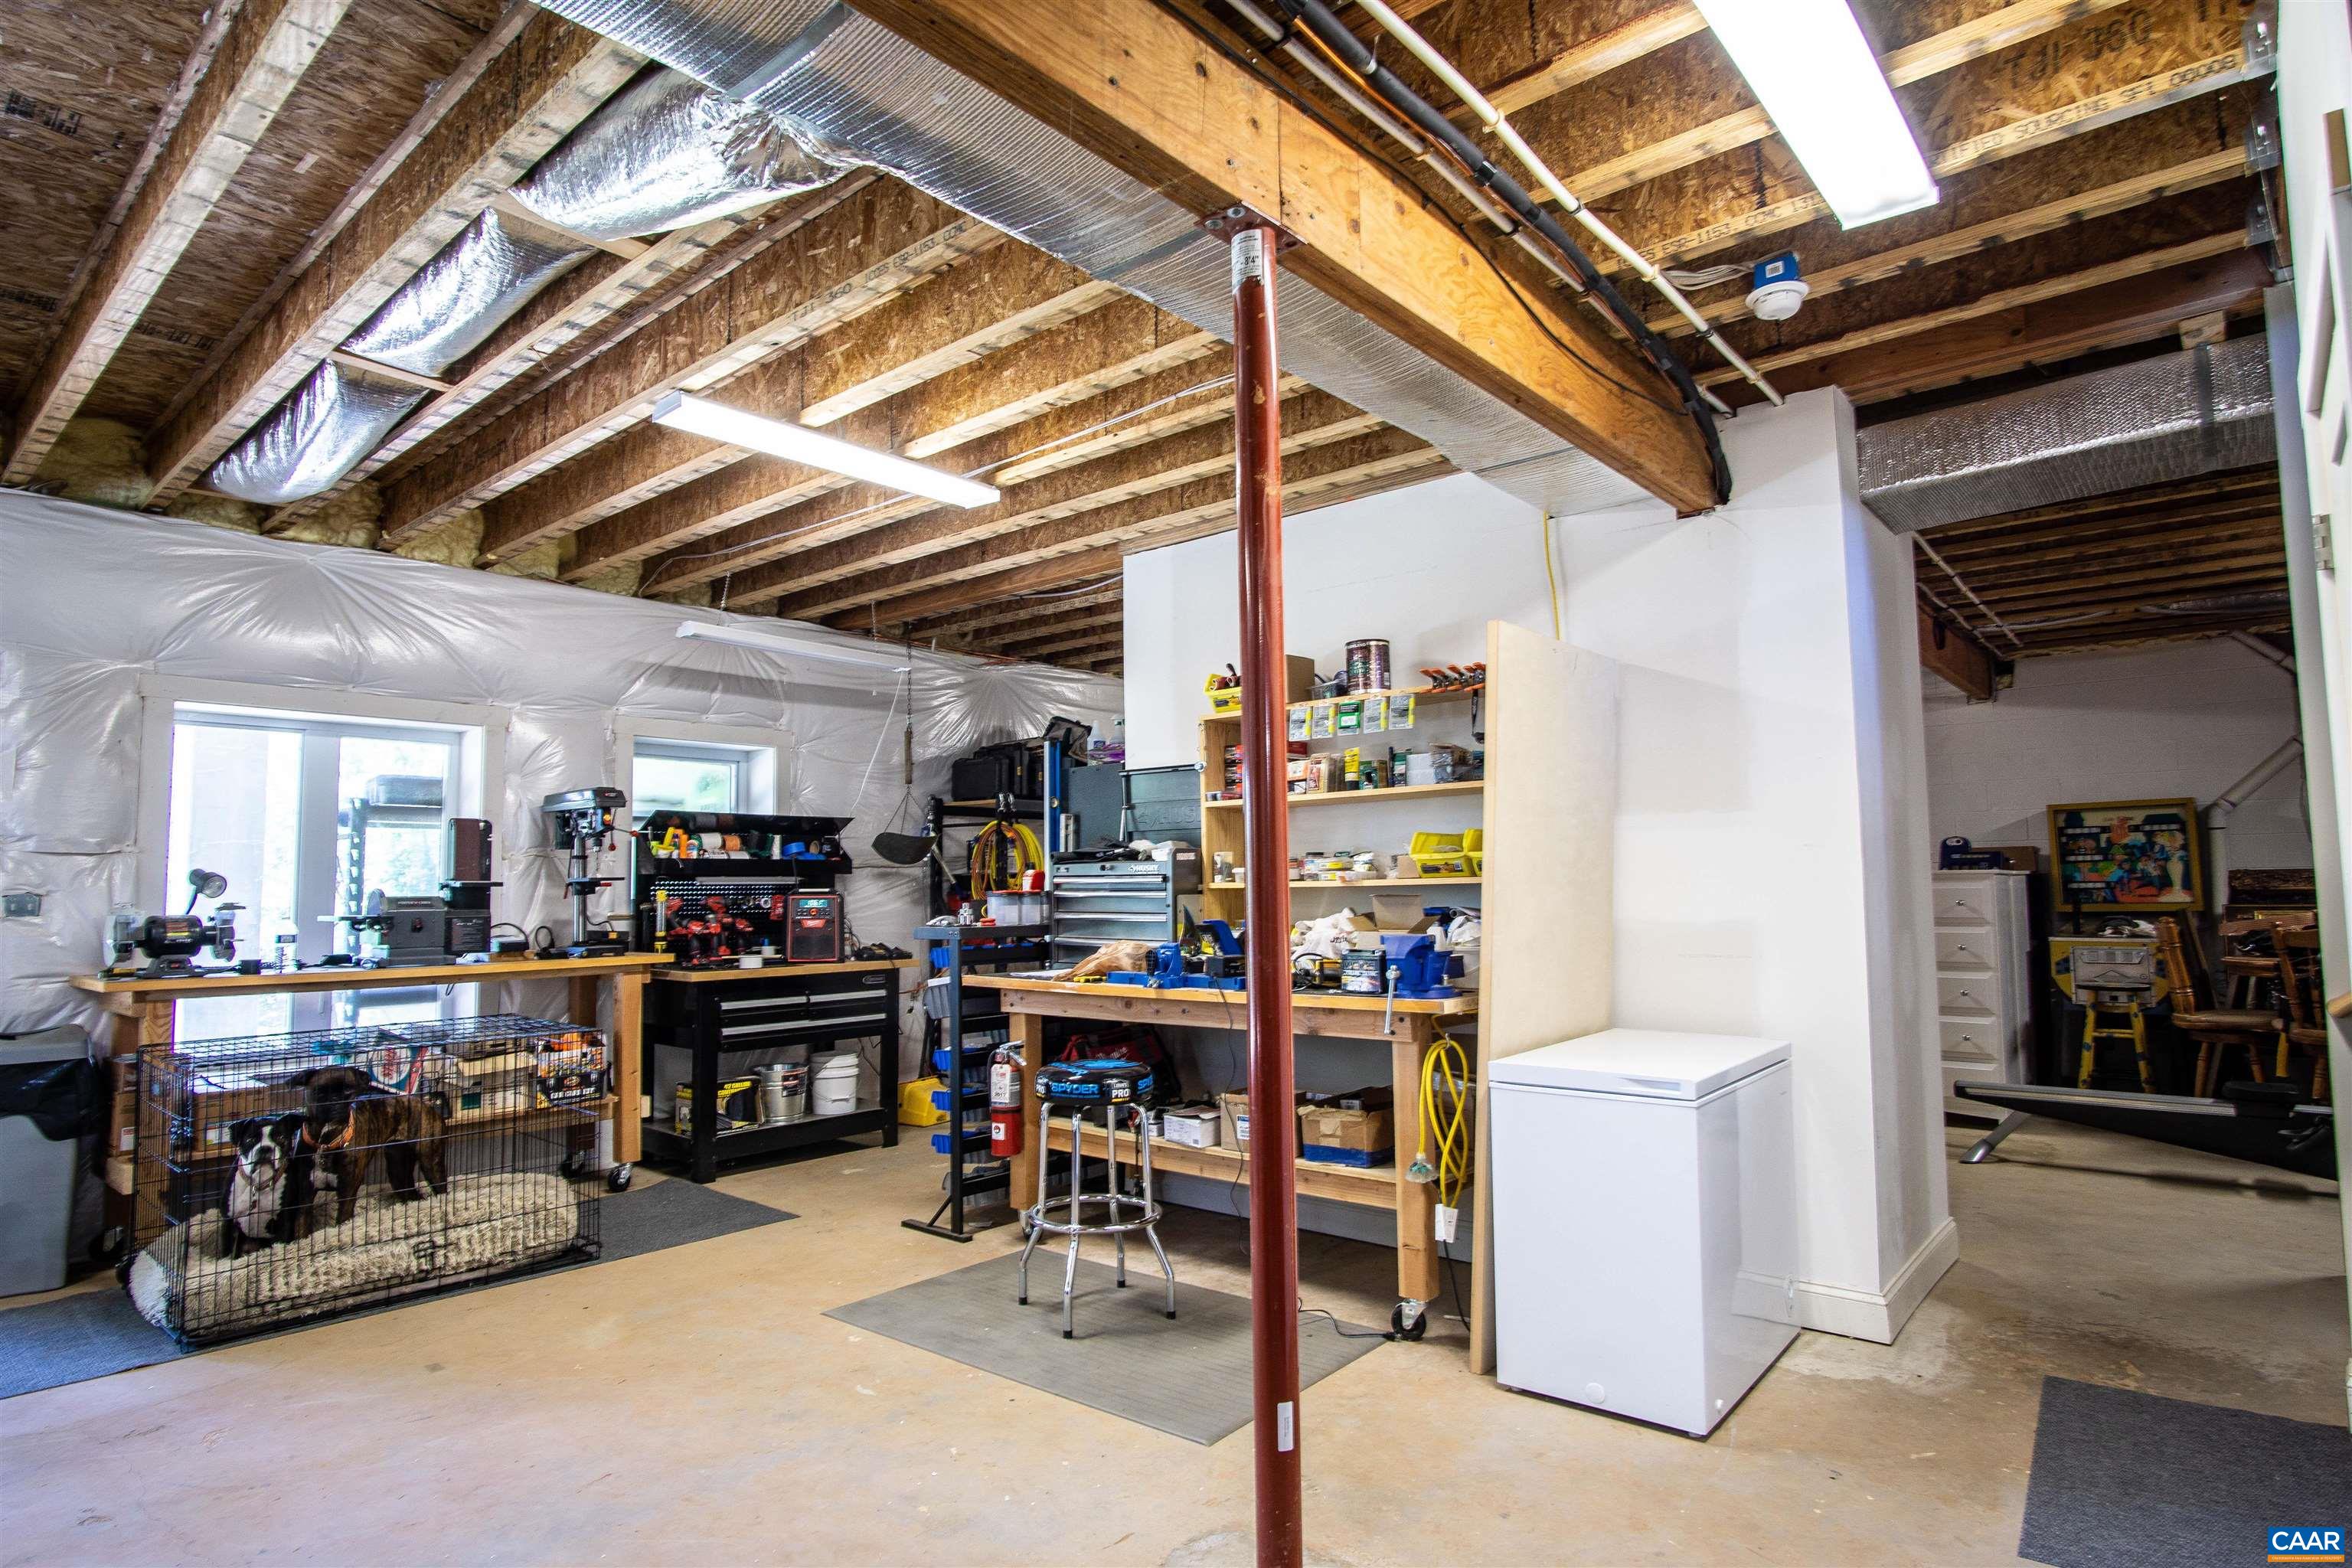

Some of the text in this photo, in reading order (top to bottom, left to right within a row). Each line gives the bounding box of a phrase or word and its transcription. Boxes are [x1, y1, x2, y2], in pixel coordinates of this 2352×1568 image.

[824, 283, 853, 303] 360
[1051, 1082, 1099, 1095] SPYDER
[1112, 1089, 1131, 1098] PRO
